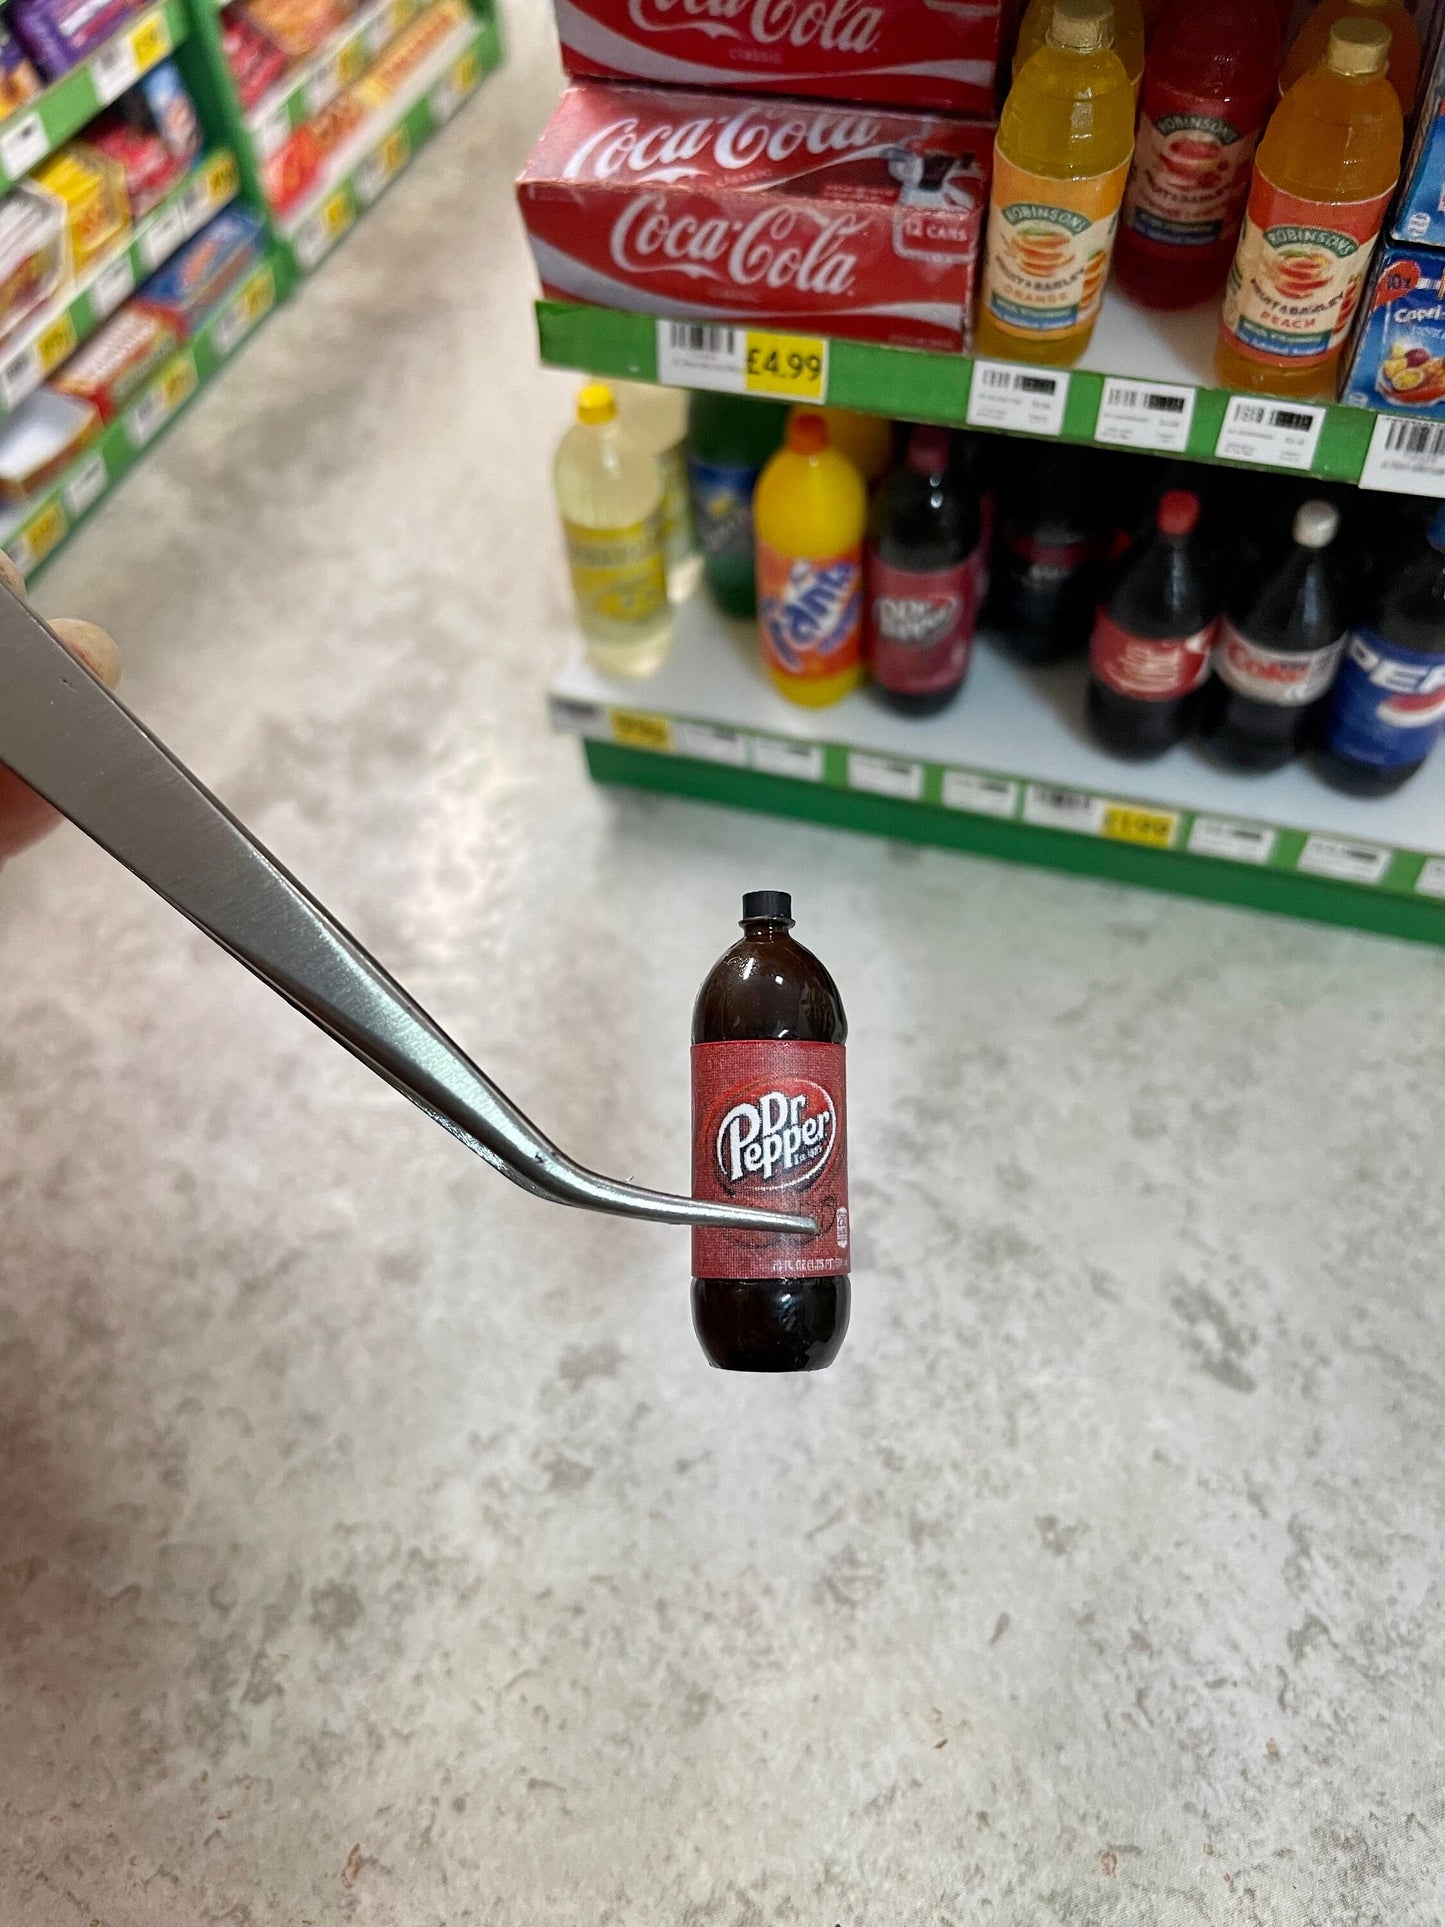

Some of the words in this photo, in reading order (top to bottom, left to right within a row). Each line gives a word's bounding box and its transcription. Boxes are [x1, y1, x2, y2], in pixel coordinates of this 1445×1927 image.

[1004, 205, 1088, 234] ROBINSONS
[1266, 227, 1354, 256] ROBINSONS
[1260, 310, 1316, 329] PEACH
[748, 348, 821, 381] £4.99
[758, 1091, 807, 1138] Dr
[716, 1103, 830, 1182] Pepper
